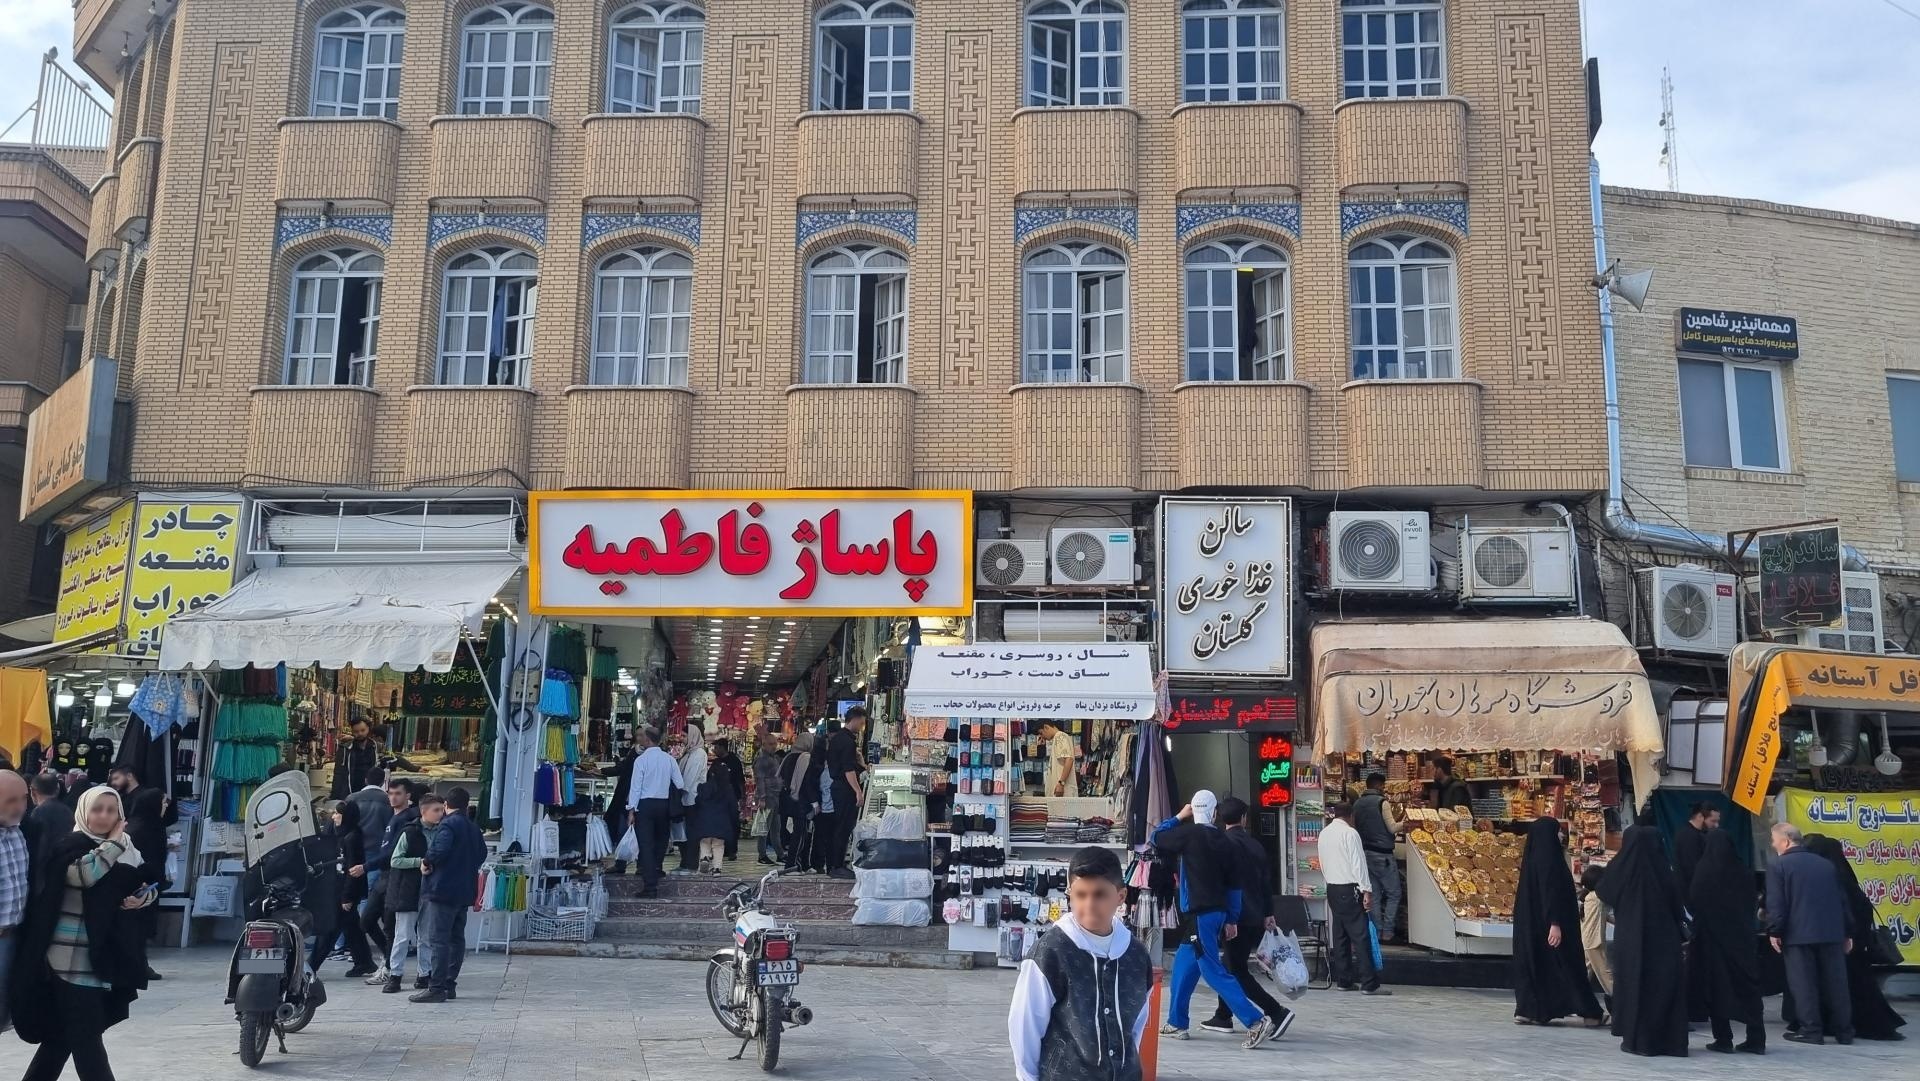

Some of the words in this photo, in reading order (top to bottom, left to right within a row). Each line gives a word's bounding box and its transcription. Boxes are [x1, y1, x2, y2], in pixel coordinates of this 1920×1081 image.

[1686, 312, 1728, 330] شاهین
[142, 505, 234, 541] چادر
[1199, 505, 1254, 557] سالن
[138, 546, 230, 571] مقنعه
[562, 502, 772, 596] فاطمیه
[779, 508, 938, 602] پاساژ
[1718, 587, 1731, 595] TCL
[1762, 573, 1840, 616] فلافل
[1193, 600, 1268, 660] گلستان
[937, 650, 986, 658] مقنعه
[999, 651, 1063, 661] روسری
[1077, 649, 1130, 660] شال
[950, 667, 1013, 679] جوراب
[1027, 669, 1064, 677] دست
[1068, 669, 1110, 680] ساق
[1807, 663, 1880, 687] آستانه
[943, 699, 964, 711] حجاب
[1109, 700, 1138, 712] فروشگاه
[1508, 674, 1633, 718] فروشگاه
[1260, 737, 1292, 758] رستوران
[1260, 761, 1291, 783] گلستان
[1744, 764, 1762, 799] آستانه
[1808, 796, 1856, 823] آستانه
[1840, 839, 1864, 865] رمضا
[1865, 839, 1892, 865] مبارک
[1890, 874, 1920, 906] سافران
[771, 960, 792, 970] ۶۱۵
[760, 973, 795, 984] ۶۱۹۷۶
